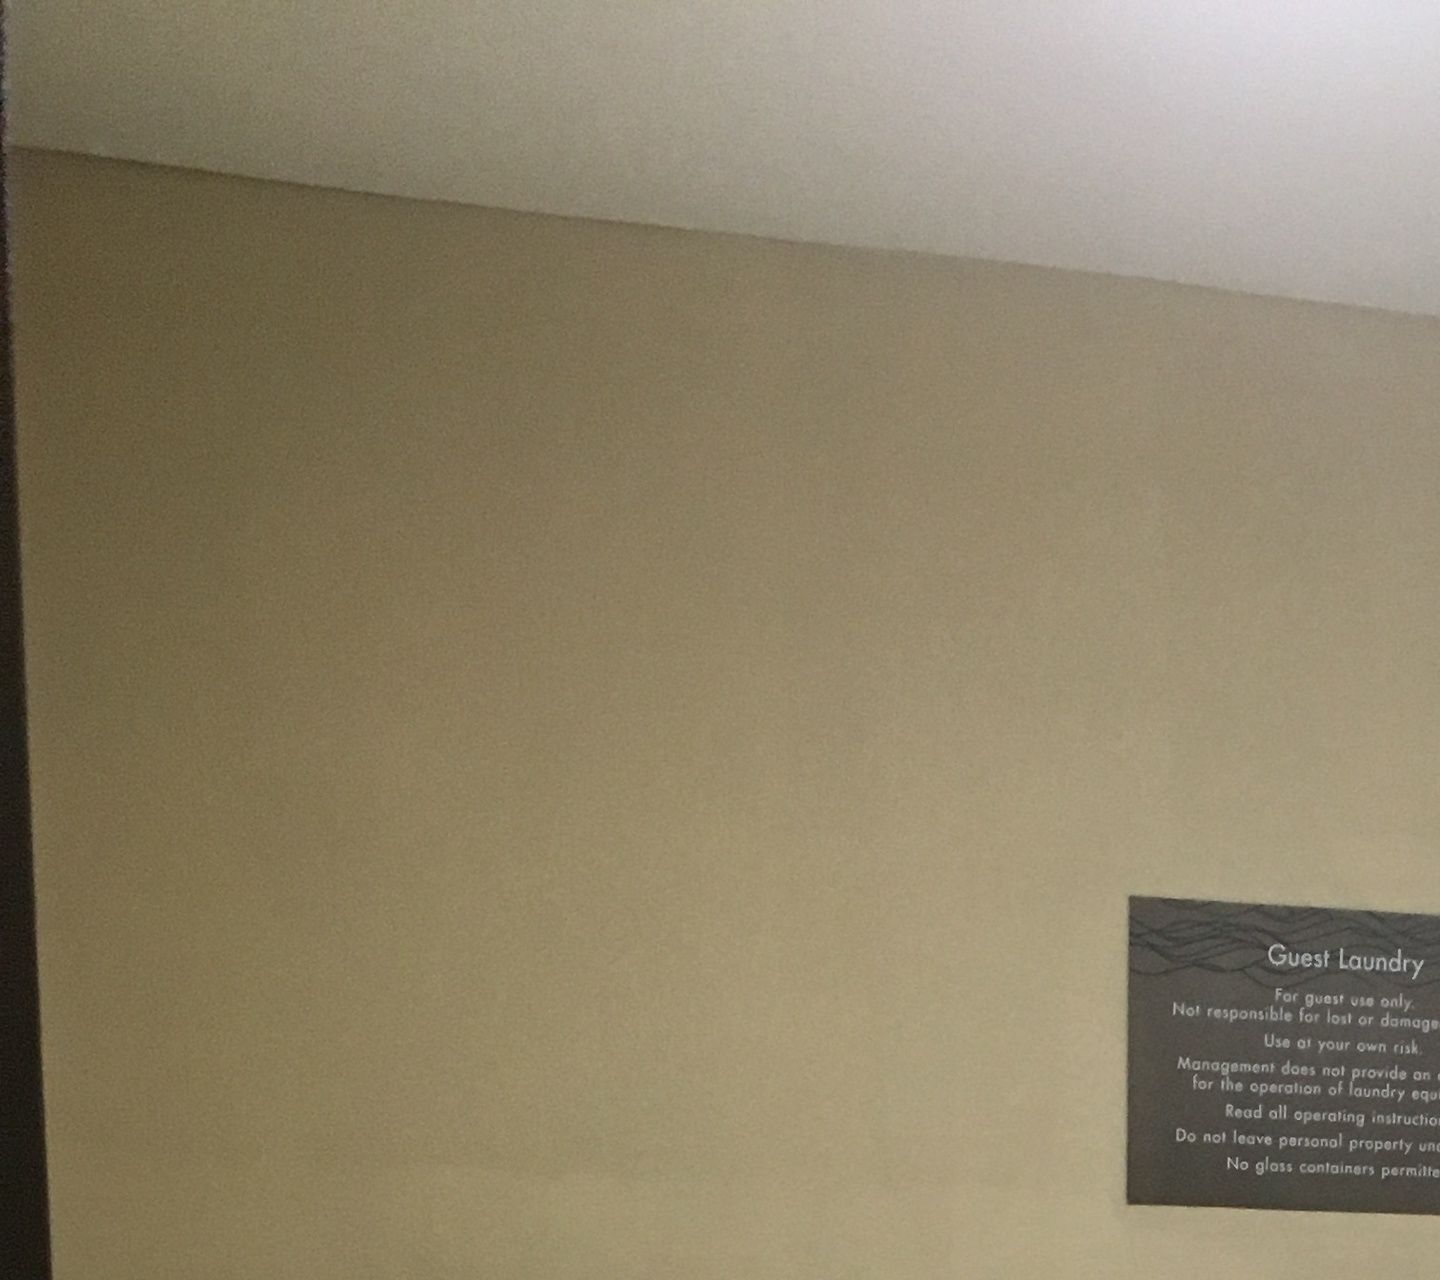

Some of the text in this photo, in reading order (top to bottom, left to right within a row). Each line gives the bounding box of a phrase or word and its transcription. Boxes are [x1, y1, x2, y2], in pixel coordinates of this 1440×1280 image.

[1268, 943, 1425, 980] Guest Laundry
[1275, 988, 1415, 1012] For guest use only.
[1172, 1002, 1200, 1016] Not
[1207, 1006, 1293, 1022] responsible
[1299, 1007, 1320, 1022] for
[1327, 1009, 1352, 1025] lost
[1358, 1015, 1374, 1025] or
[1264, 1033, 1423, 1055] Use at your own risk.
[1177, 1056, 1275, 1075] Management
[1281, 1060, 1316, 1076] does
[1322, 1065, 1346, 1077] not
[1352, 1065, 1407, 1081] provide
[1413, 1071, 1431, 1081] an
[1192, 1074, 1213, 1090] for
[1220, 1076, 1243, 1091] the
[1250, 1082, 1321, 1096] operation
[1328, 1081, 1344, 1095] of
[1350, 1082, 1405, 1102] laundry
[1225, 1104, 1263, 1119] Read
[1269, 1105, 1287, 1120] all
[1294, 1110, 1365, 1127] operating
[1176, 1128, 1196, 1143] Do
[1203, 1132, 1226, 1143] not
[1233, 1130, 1273, 1146] leave
[1279, 1133, 1343, 1149] personal
[1350, 1139, 1413, 1155] property
[1226, 1157, 1249, 1170] No
[1255, 1156, 1293, 1176] glass
[1299, 1162, 1375, 1174] containers
